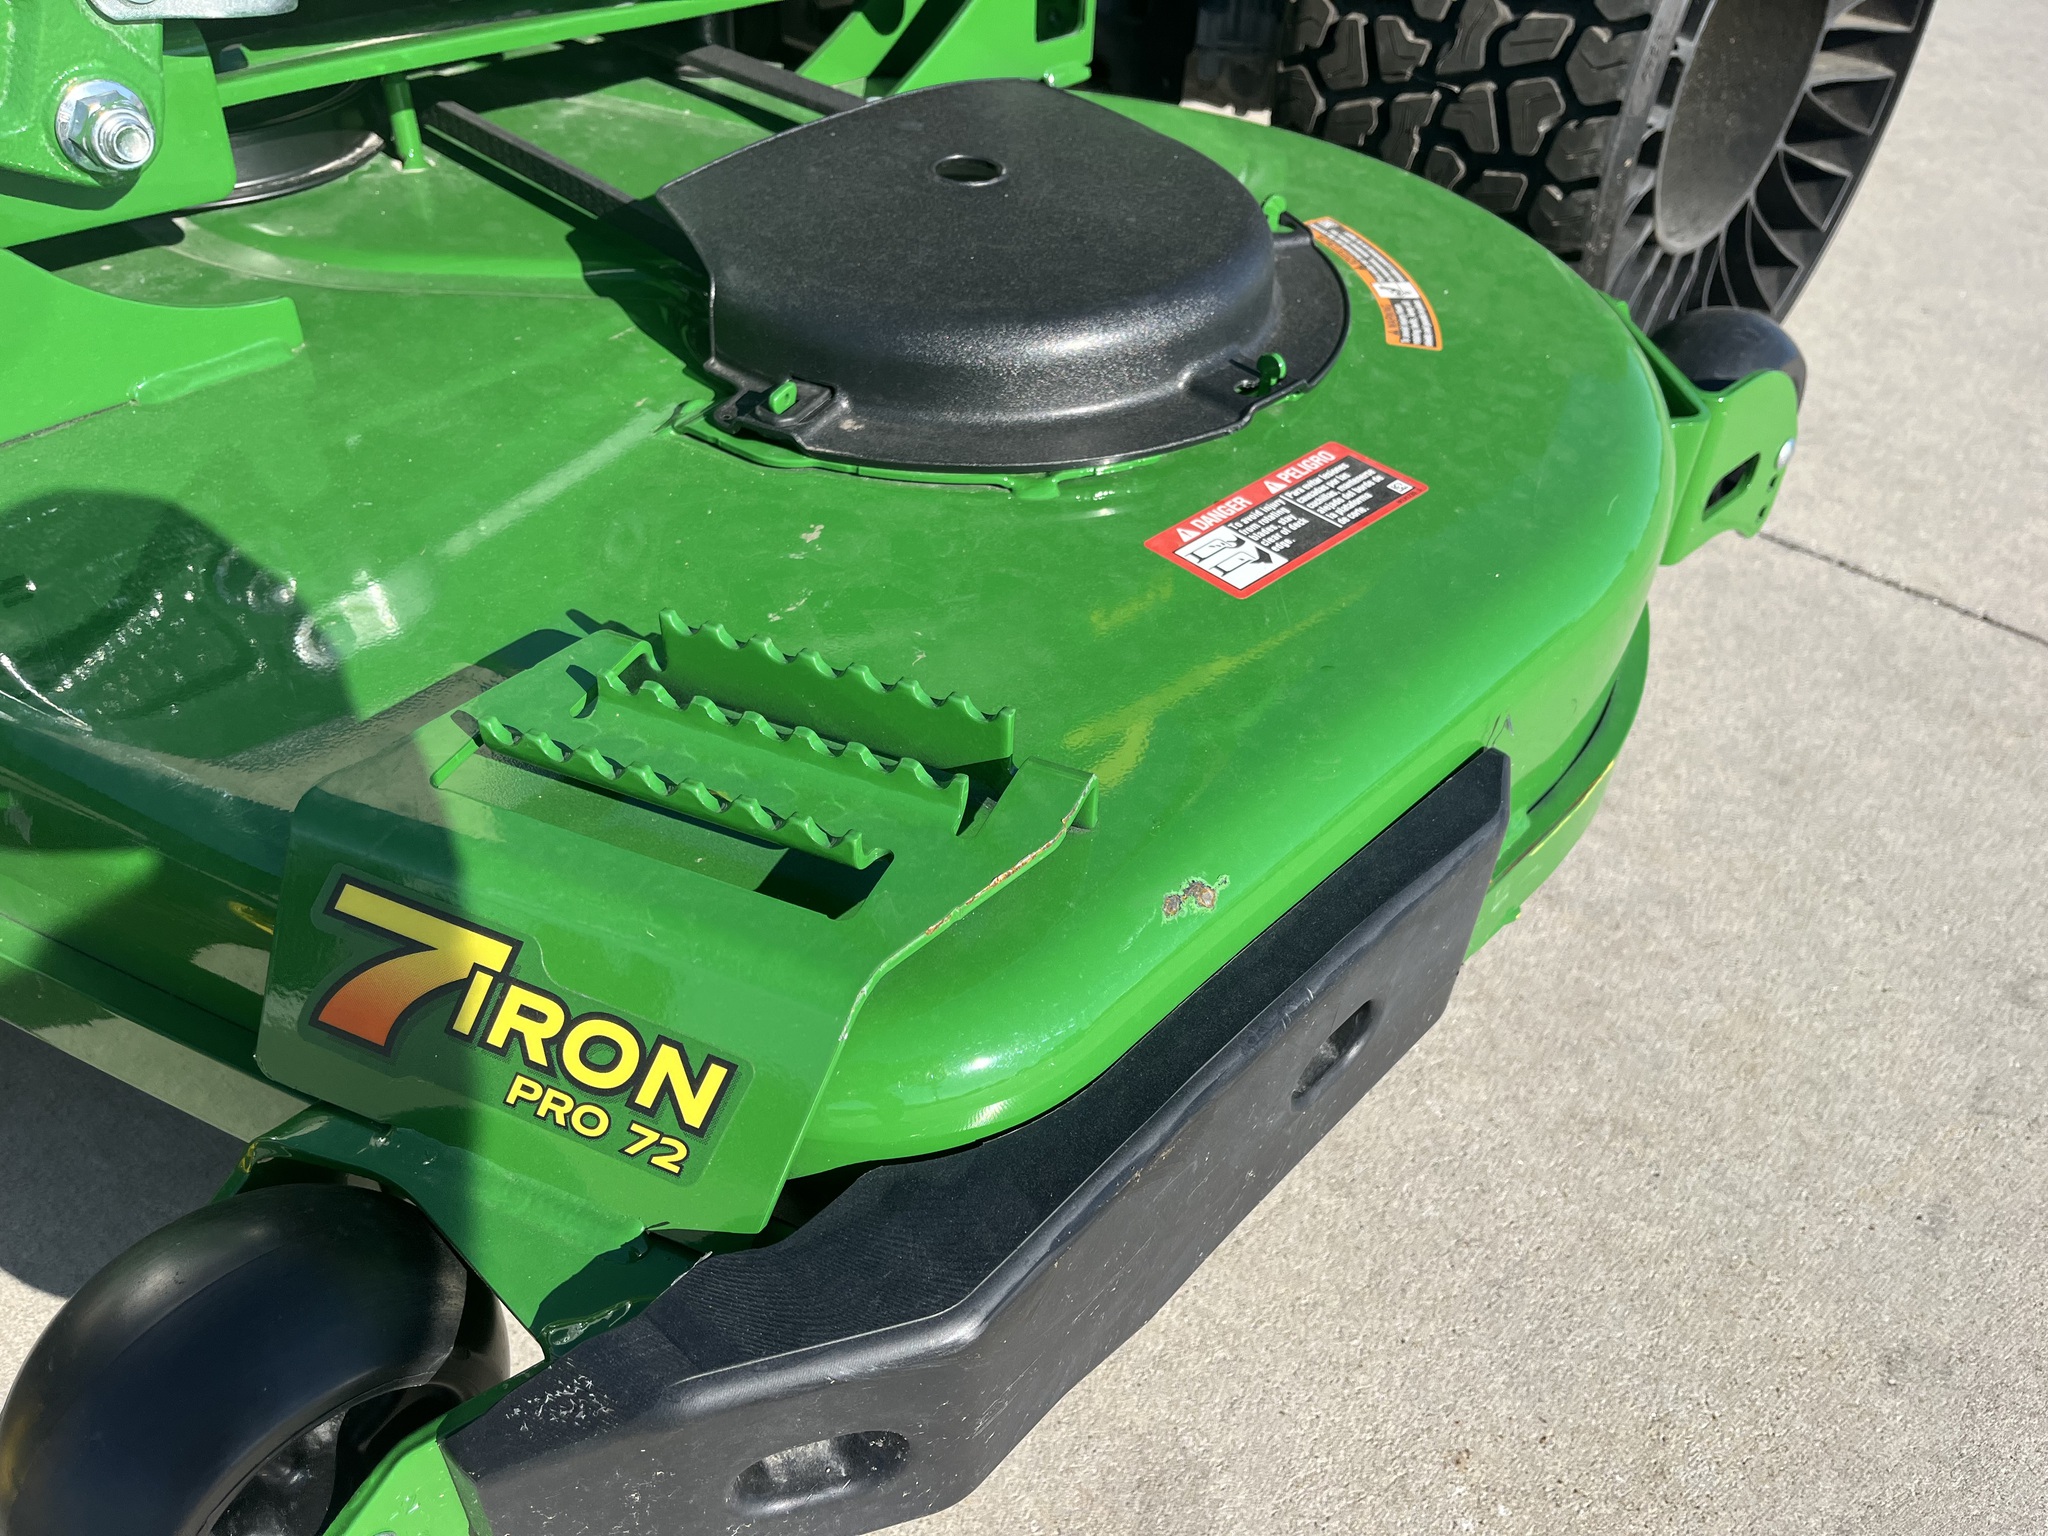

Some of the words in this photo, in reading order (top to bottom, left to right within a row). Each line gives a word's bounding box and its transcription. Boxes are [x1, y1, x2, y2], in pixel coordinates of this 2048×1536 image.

[1275, 450, 1336, 483] PELIGRO
[1286, 486, 1305, 498] Para
[1189, 495, 1252, 530] DANGER
[1229, 520, 1242, 530] To
[1239, 509, 1263, 523] avoid
[1260, 497, 1288, 512] injury
[1240, 522, 1260, 534] from
[1258, 506, 1290, 525] rotating
[1250, 522, 1281, 540] blades,
[1277, 513, 1298, 525] stay
[1261, 533, 1282, 545] clear
[1280, 527, 1291, 535] of
[1288, 517, 1309, 529] deck
[1271, 537, 1296, 552] edge.
[450, 969, 729, 1130] IRON
[507, 1074, 610, 1138] PRO
[622, 1124, 689, 1174] 72
